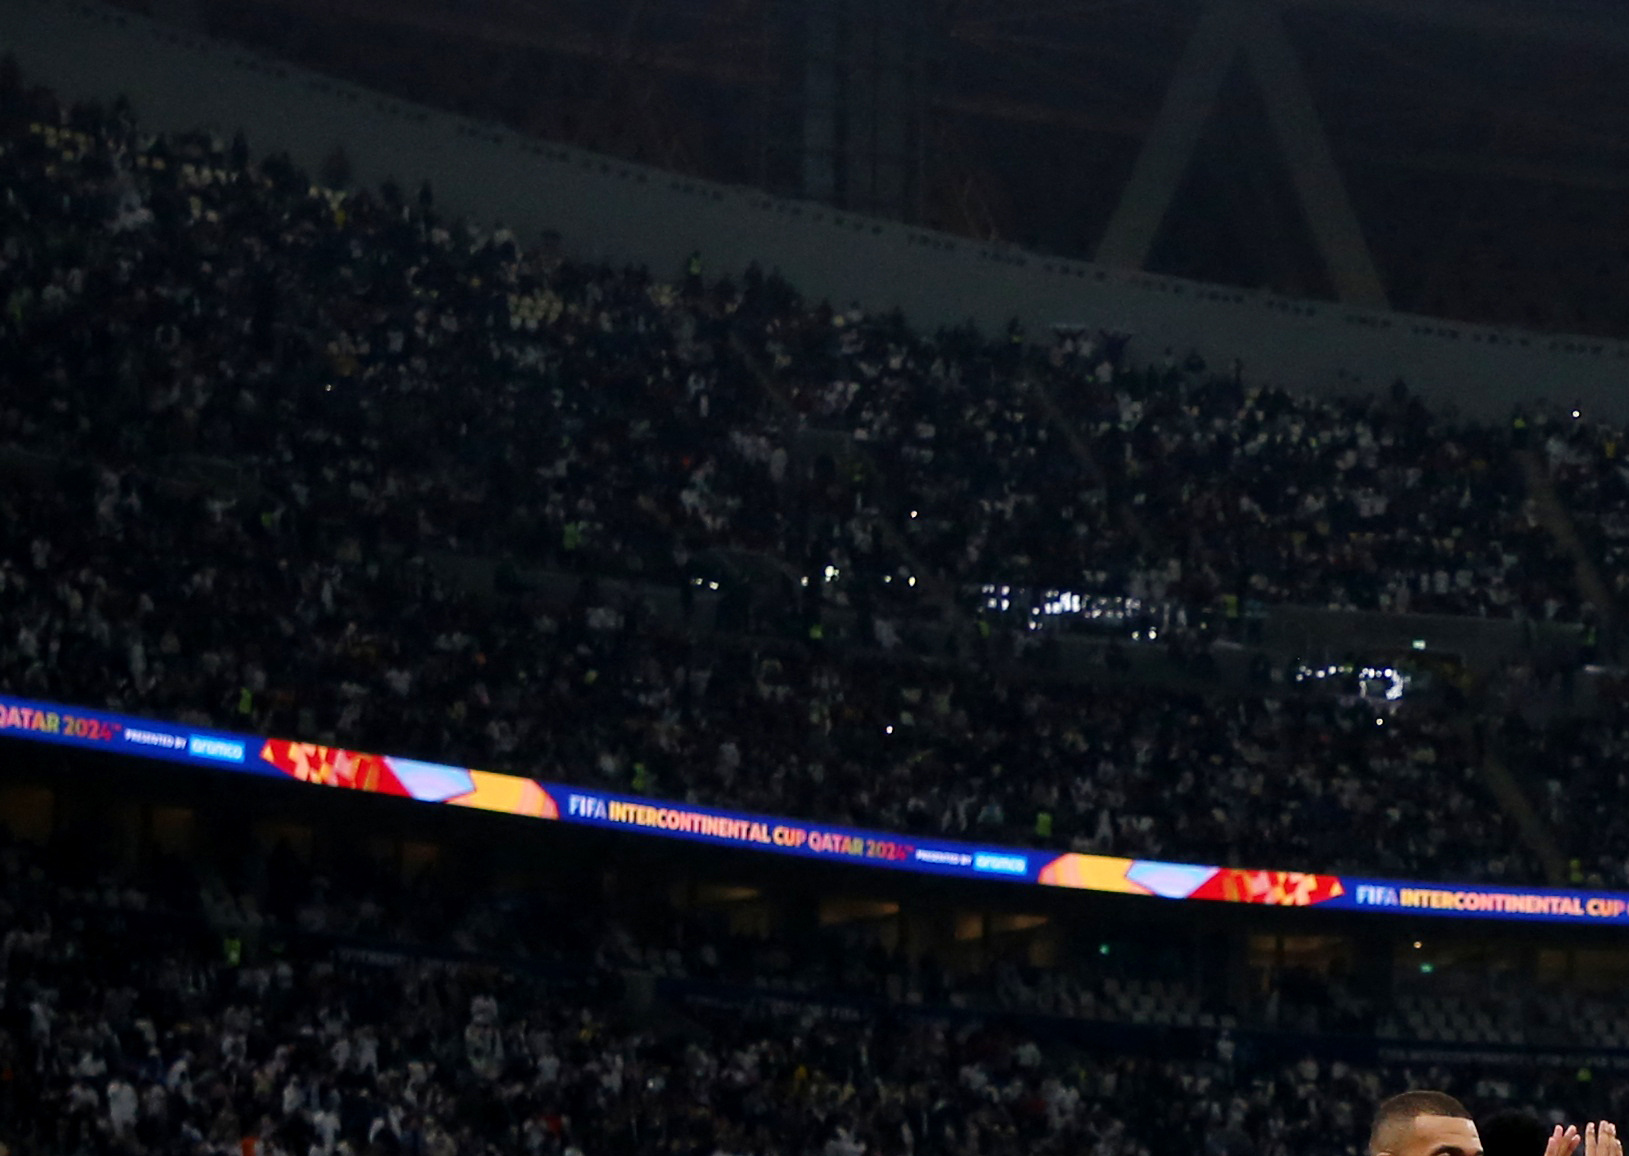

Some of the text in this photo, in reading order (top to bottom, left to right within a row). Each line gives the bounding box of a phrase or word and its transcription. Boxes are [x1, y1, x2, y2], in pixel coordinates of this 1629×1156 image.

[568, 794, 607, 820] FIFA
[608, 800, 771, 844] INTERCONTINENTAL
[773, 825, 807, 848] CUP
[808, 831, 864, 856] QATAR
[1356, 885, 1399, 906] FIFA
[1400, 888, 1584, 916] INTERCONTINENTAL
[1586, 898, 1625, 918] CUP
